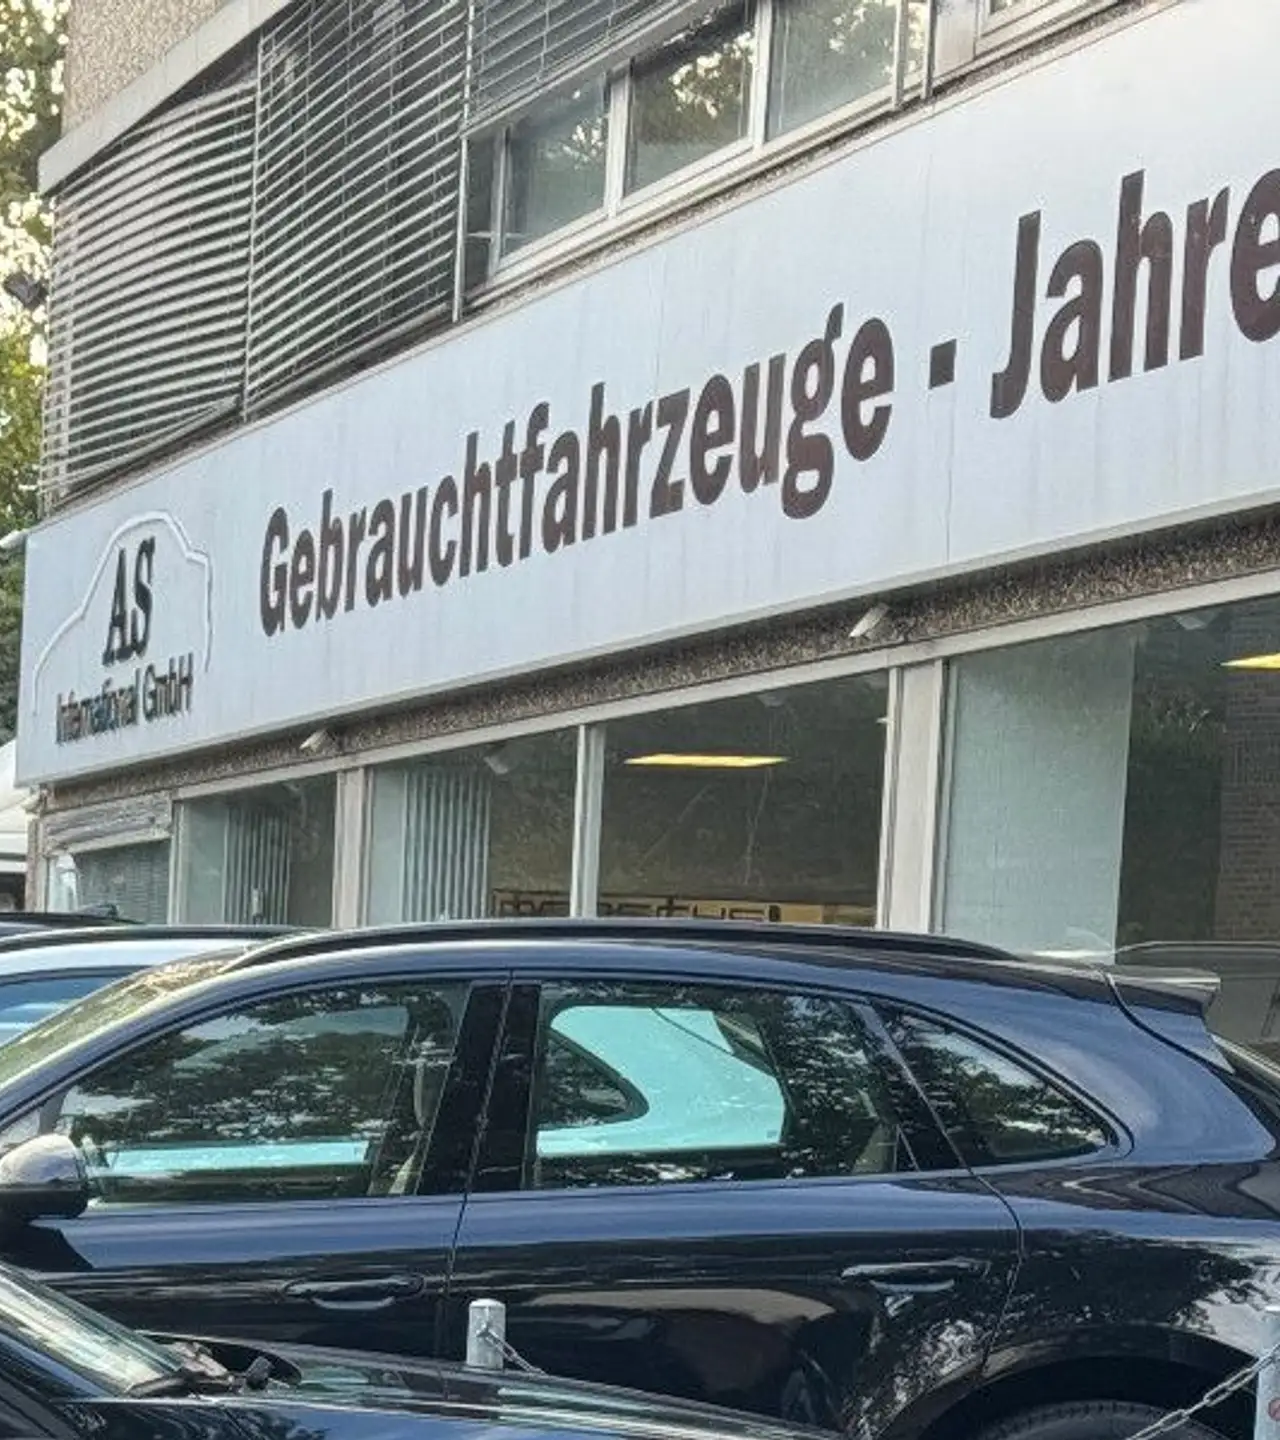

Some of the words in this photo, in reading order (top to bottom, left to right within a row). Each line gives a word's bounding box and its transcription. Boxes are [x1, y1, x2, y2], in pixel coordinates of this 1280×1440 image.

[259, 301, 895, 638] Gebrauchtfahrzeuge
[929, 338, 957, 390] -
[989, 168, 1280, 419] Jahre
[102, 536, 156, 667] AS
[142, 652, 194, 722] GmbH
